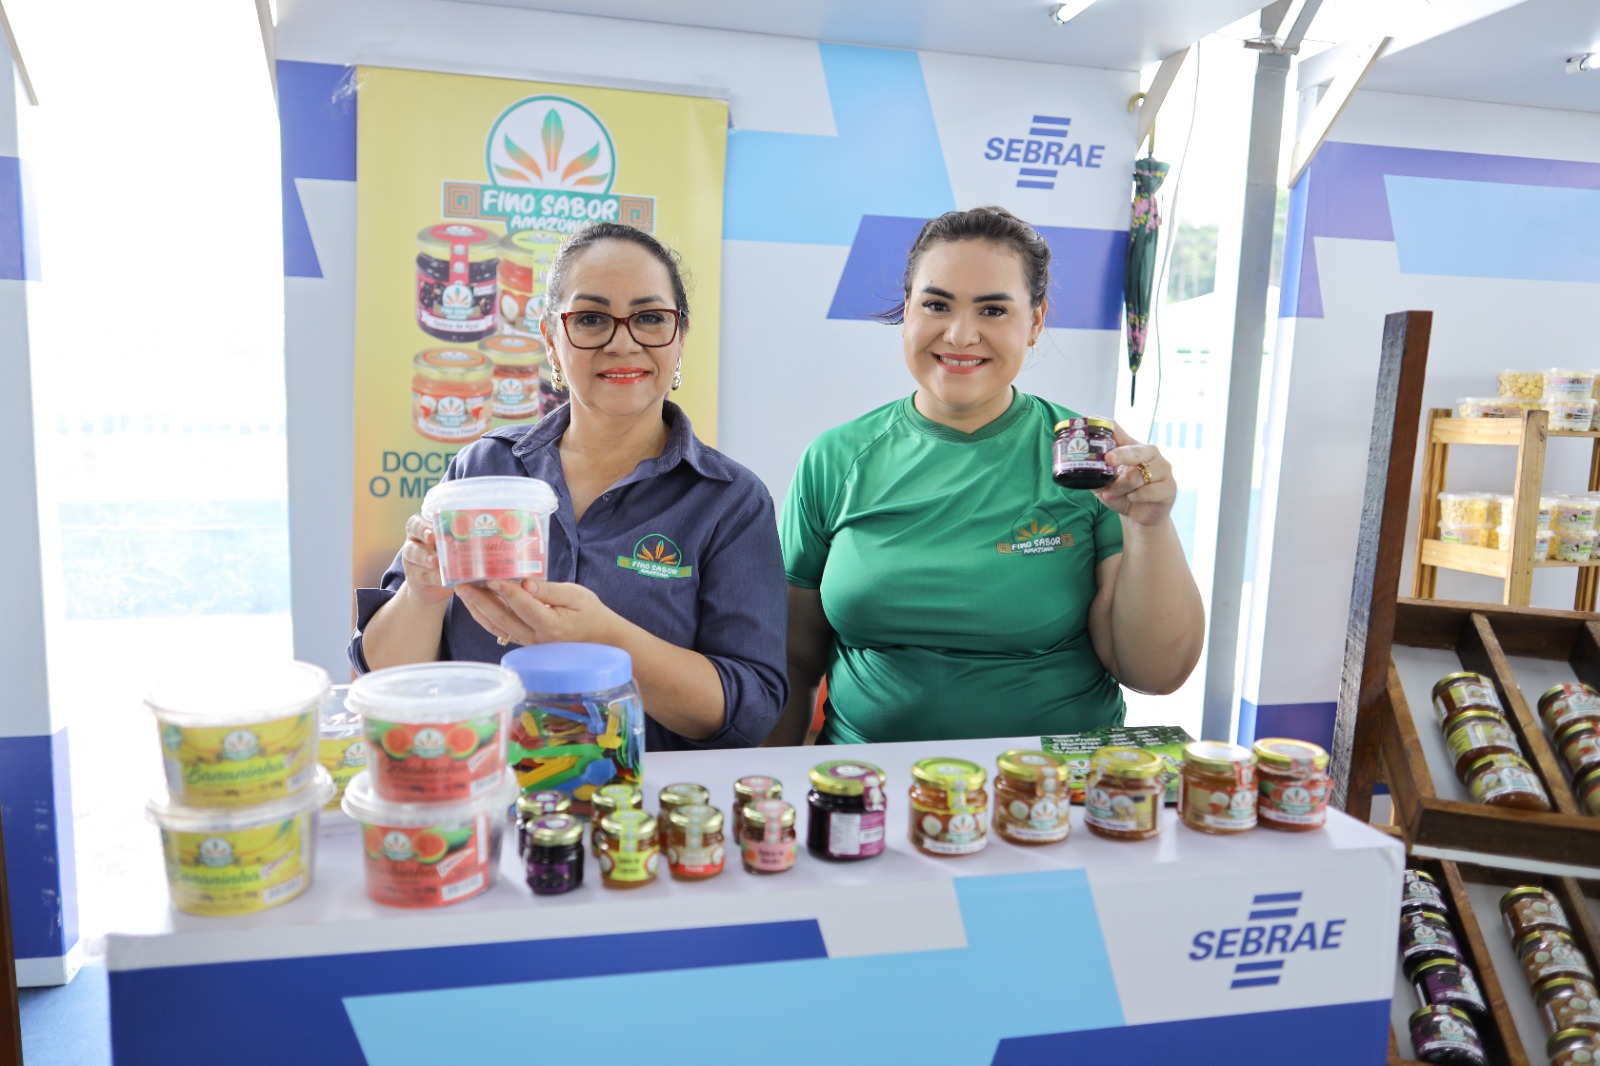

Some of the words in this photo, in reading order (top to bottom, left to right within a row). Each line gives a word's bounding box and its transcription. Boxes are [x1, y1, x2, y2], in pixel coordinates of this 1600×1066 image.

[984, 136, 1106, 169] SEBRAE
[482, 189, 536, 214] FINO
[541, 194, 619, 221] SABOR
[369, 476, 391, 498] O
[1011, 542, 1032, 550] FINO
[1034, 537, 1061, 546] SABOR
[632, 561, 650, 570] FINO
[652, 564, 678, 576] SABOR
[1188, 918, 1347, 961] SEBRAE
